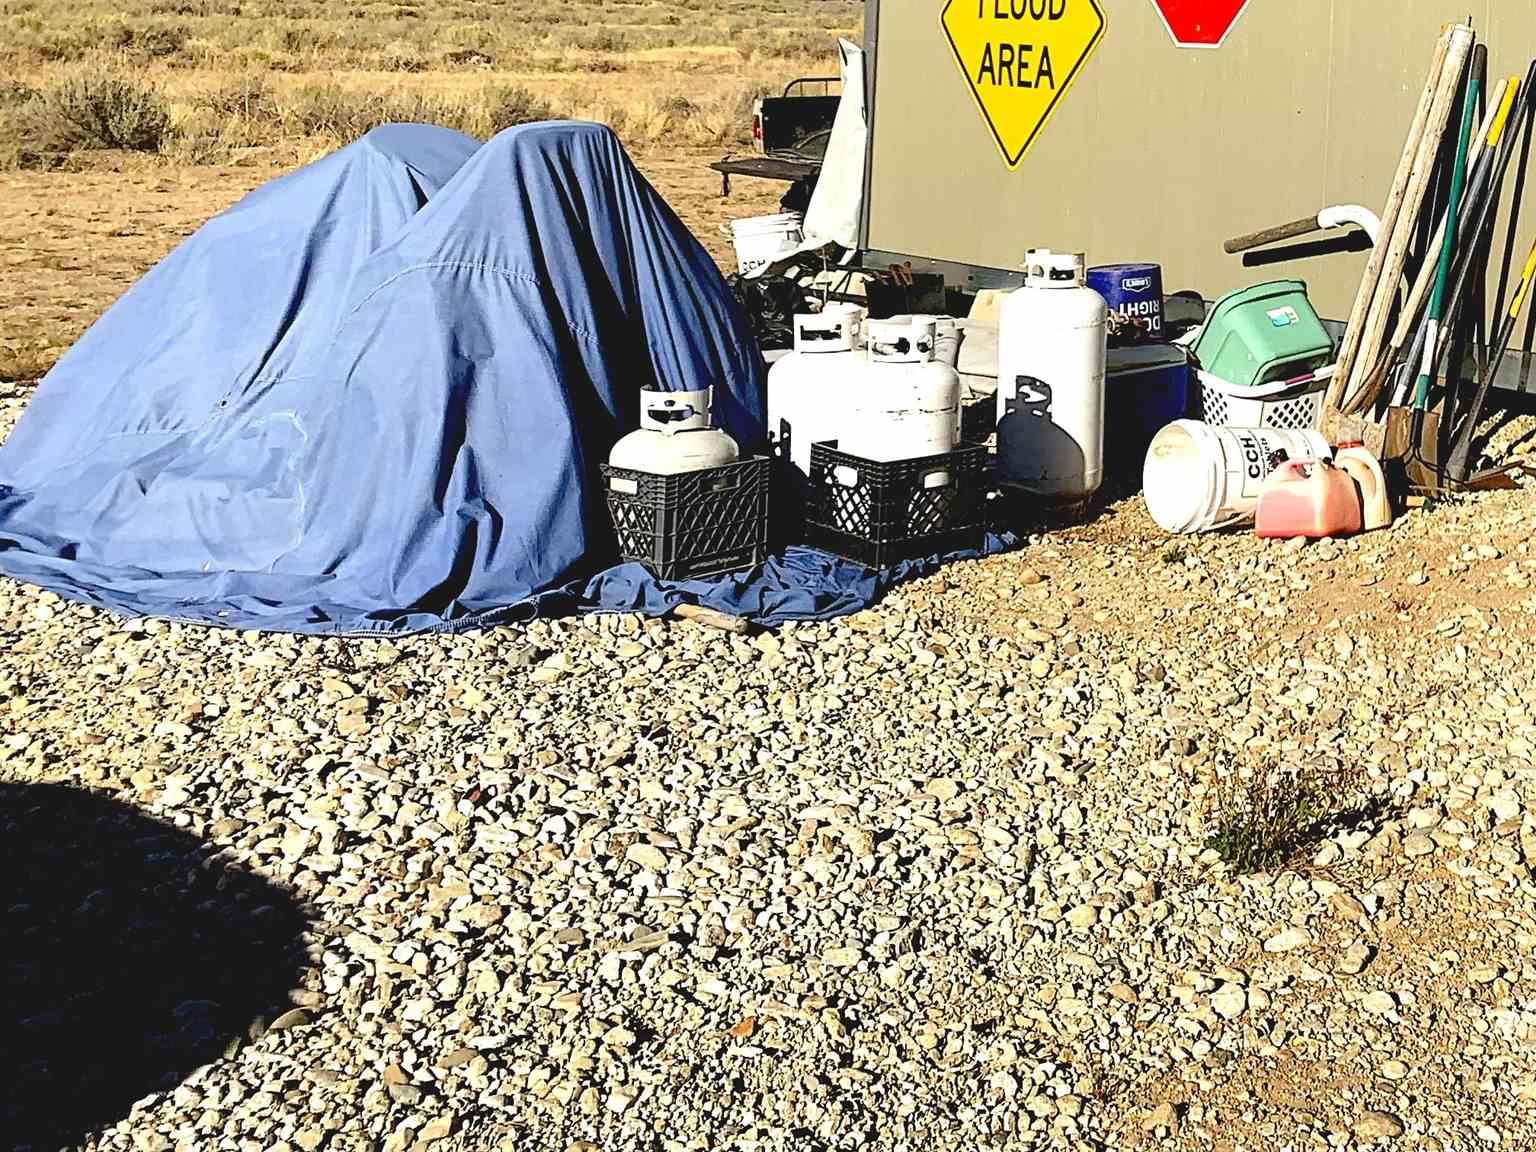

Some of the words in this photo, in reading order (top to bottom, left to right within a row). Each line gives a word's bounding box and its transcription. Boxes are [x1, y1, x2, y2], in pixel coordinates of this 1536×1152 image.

[977, 42, 1055, 90] AREA
[1119, 299, 1160, 317] RIGHT
[1240, 437, 1261, 479] CCH
